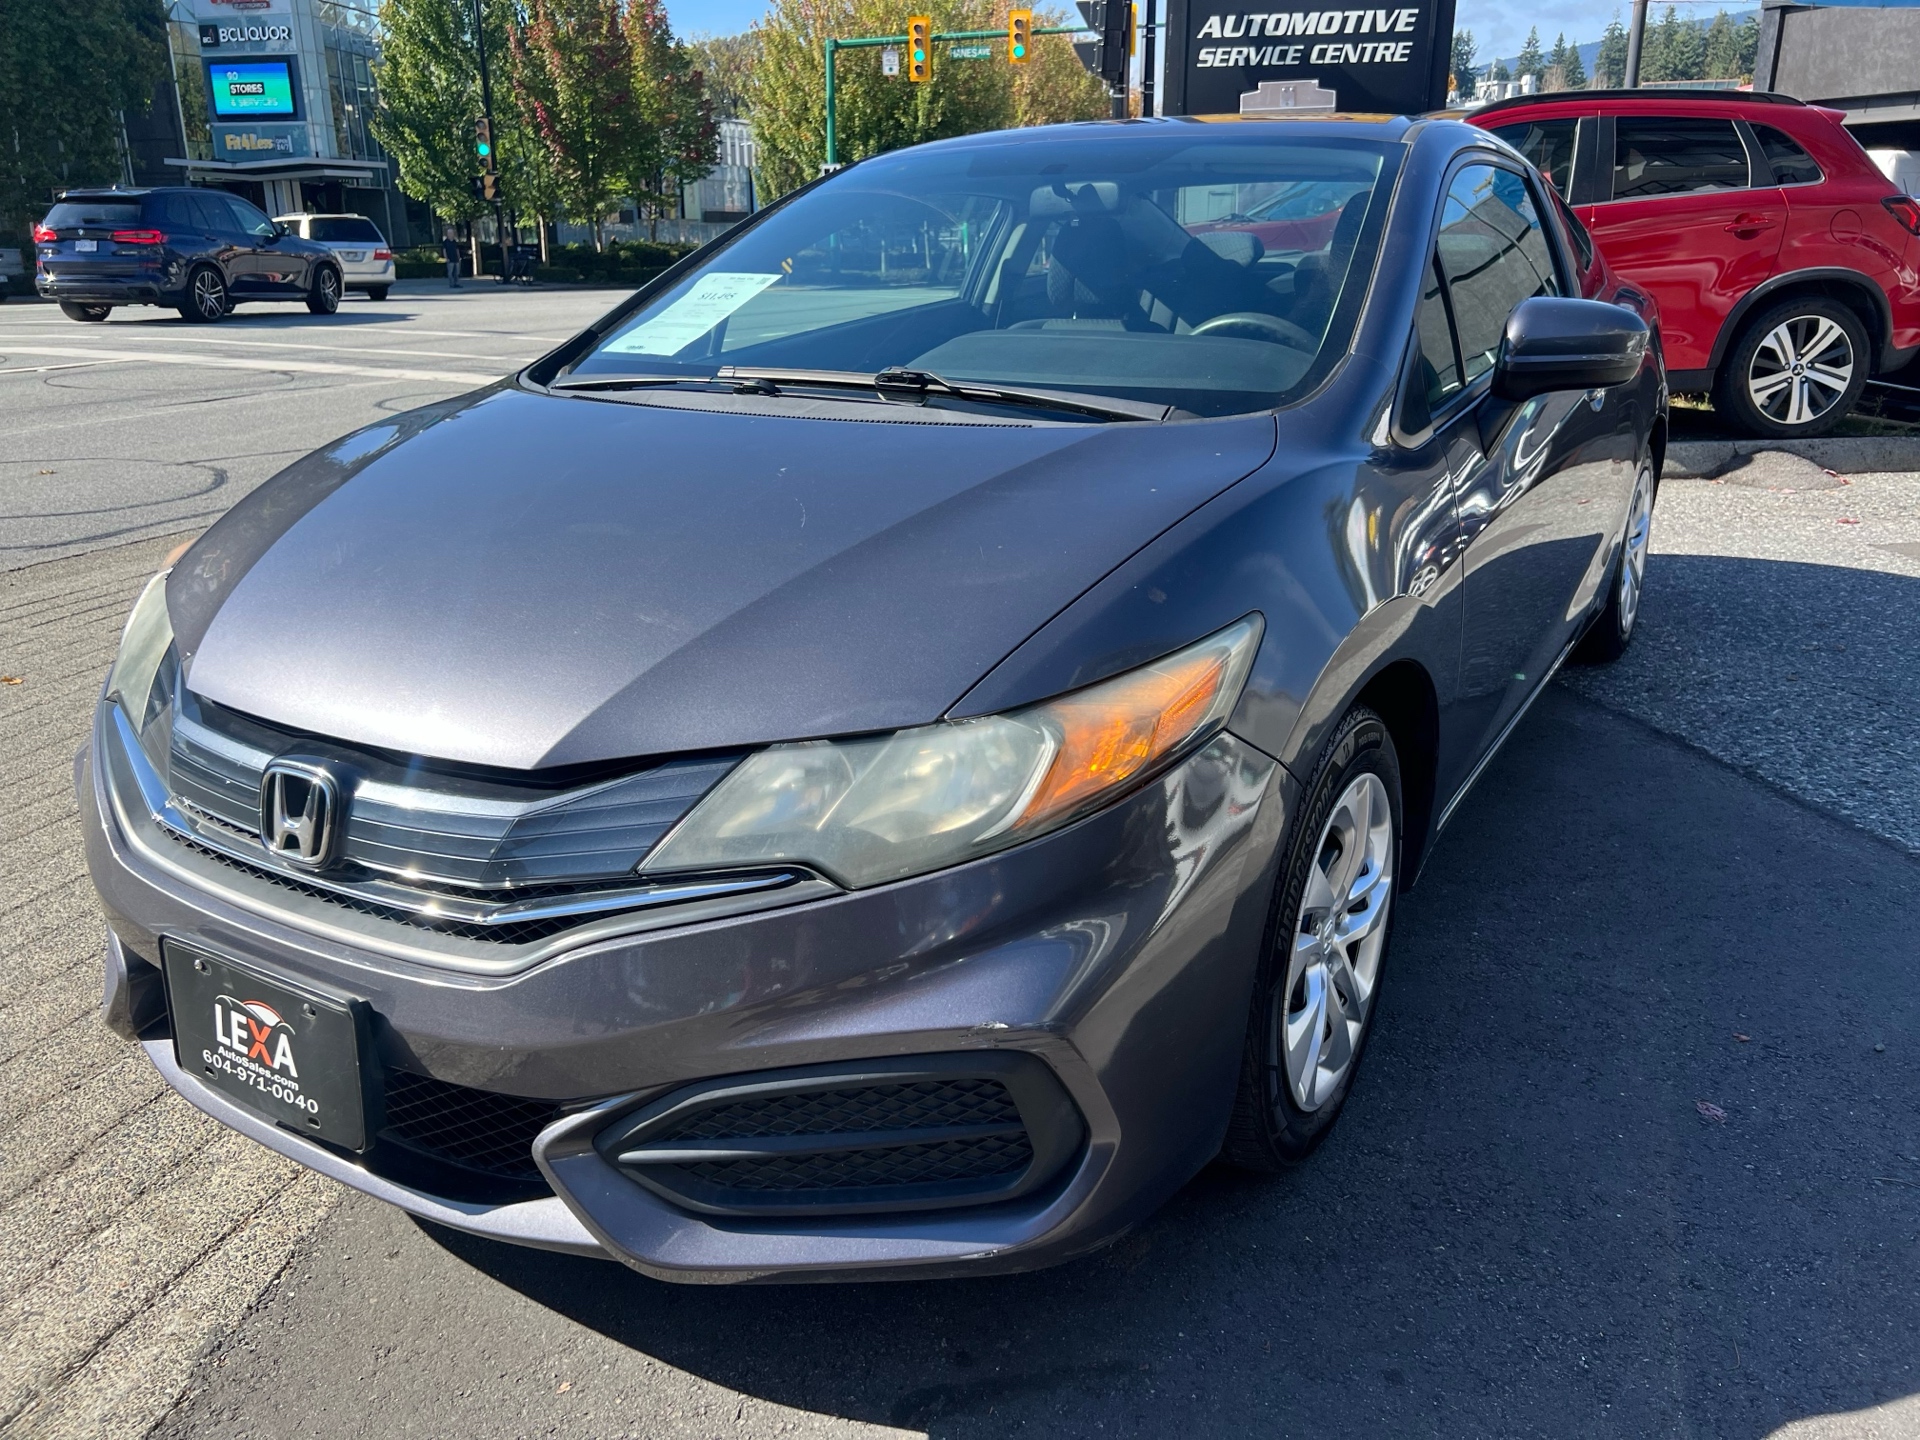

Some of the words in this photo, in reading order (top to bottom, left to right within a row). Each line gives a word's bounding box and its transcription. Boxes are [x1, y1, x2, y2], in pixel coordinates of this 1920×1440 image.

[1196, 8, 1420, 39] AUTOMOTIVE
[1196, 45, 1305, 68] SERVICE
[1309, 42, 1414, 65] CENTRE
[230, 84, 263, 94] STORES
[1278, 773, 1335, 951] BRIDGESTONE
[214, 1003, 299, 1078] LEXA
[202, 1048, 319, 1114] 604-971-0040
[217, 1045, 299, 1092] AutoSales.com
